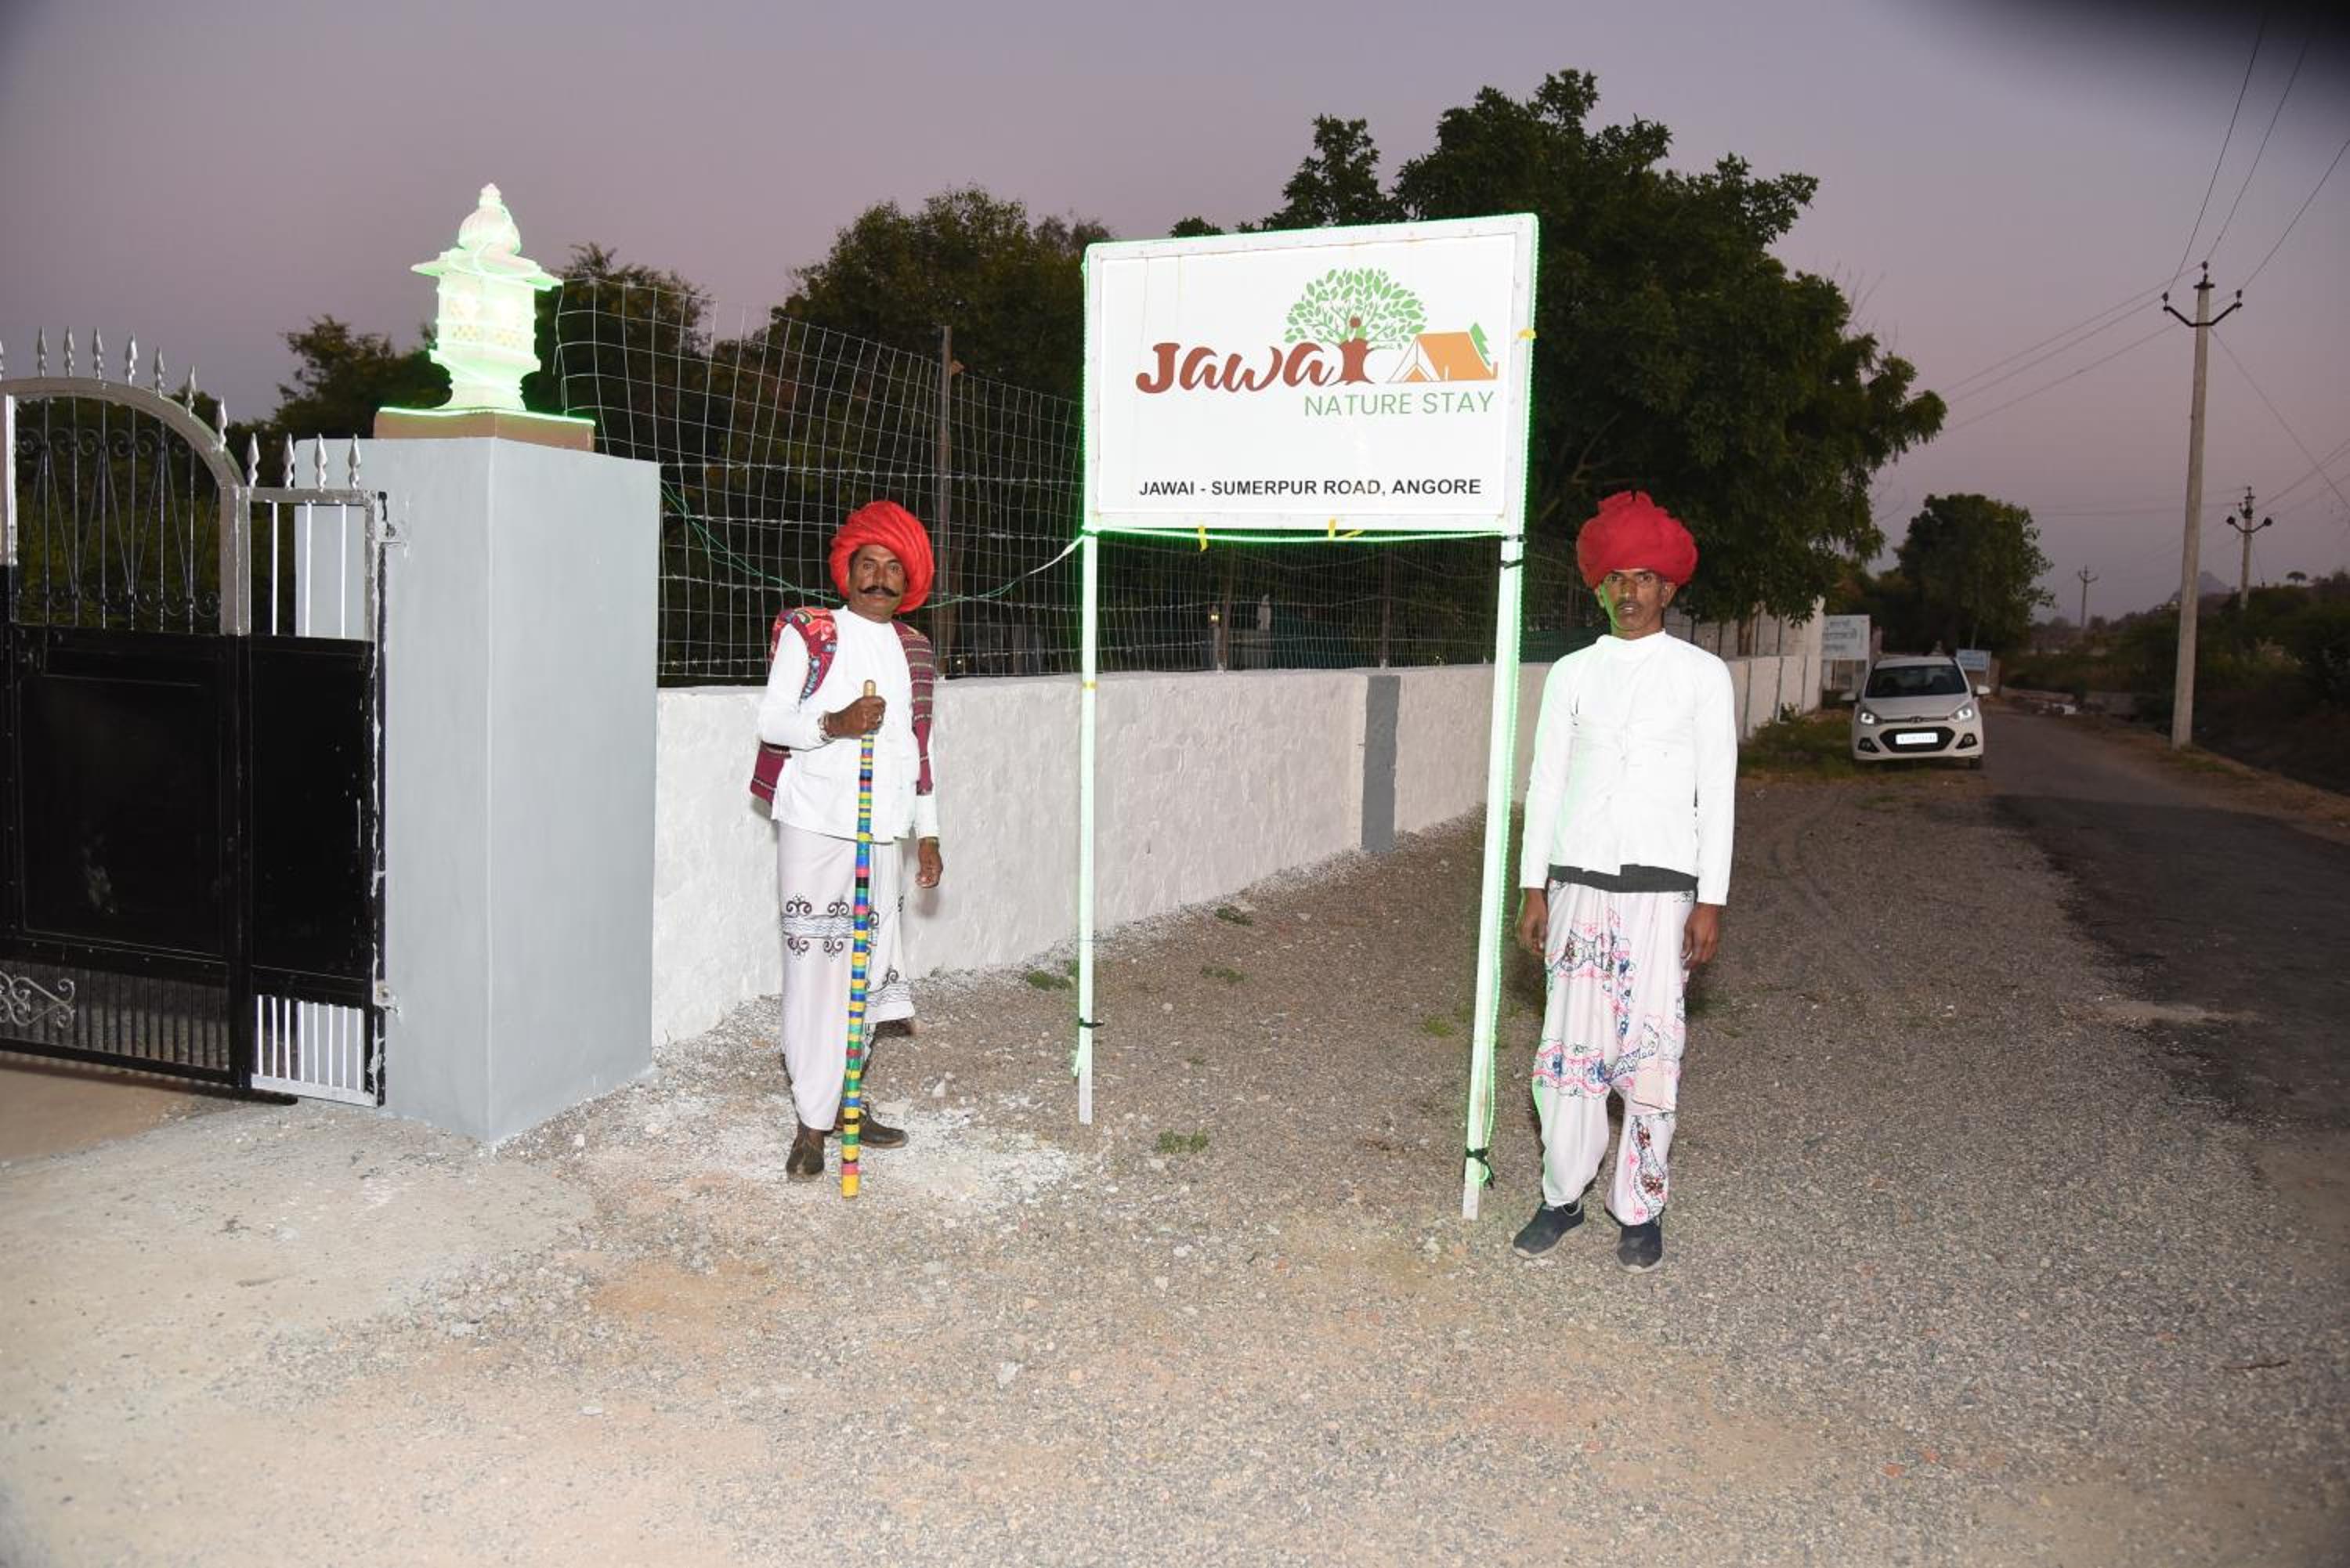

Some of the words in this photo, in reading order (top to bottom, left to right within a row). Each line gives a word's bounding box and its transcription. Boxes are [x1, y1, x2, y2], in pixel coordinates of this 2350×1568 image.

[1304, 392, 1412, 417] NATURE
[1422, 391, 1494, 414] STAY
[1139, 481, 1195, 496] JAWAI
[1211, 480, 1317, 496] SUMERPUR
[1323, 479, 1386, 497] ROAD,
[1391, 479, 1481, 495] ANGORE
